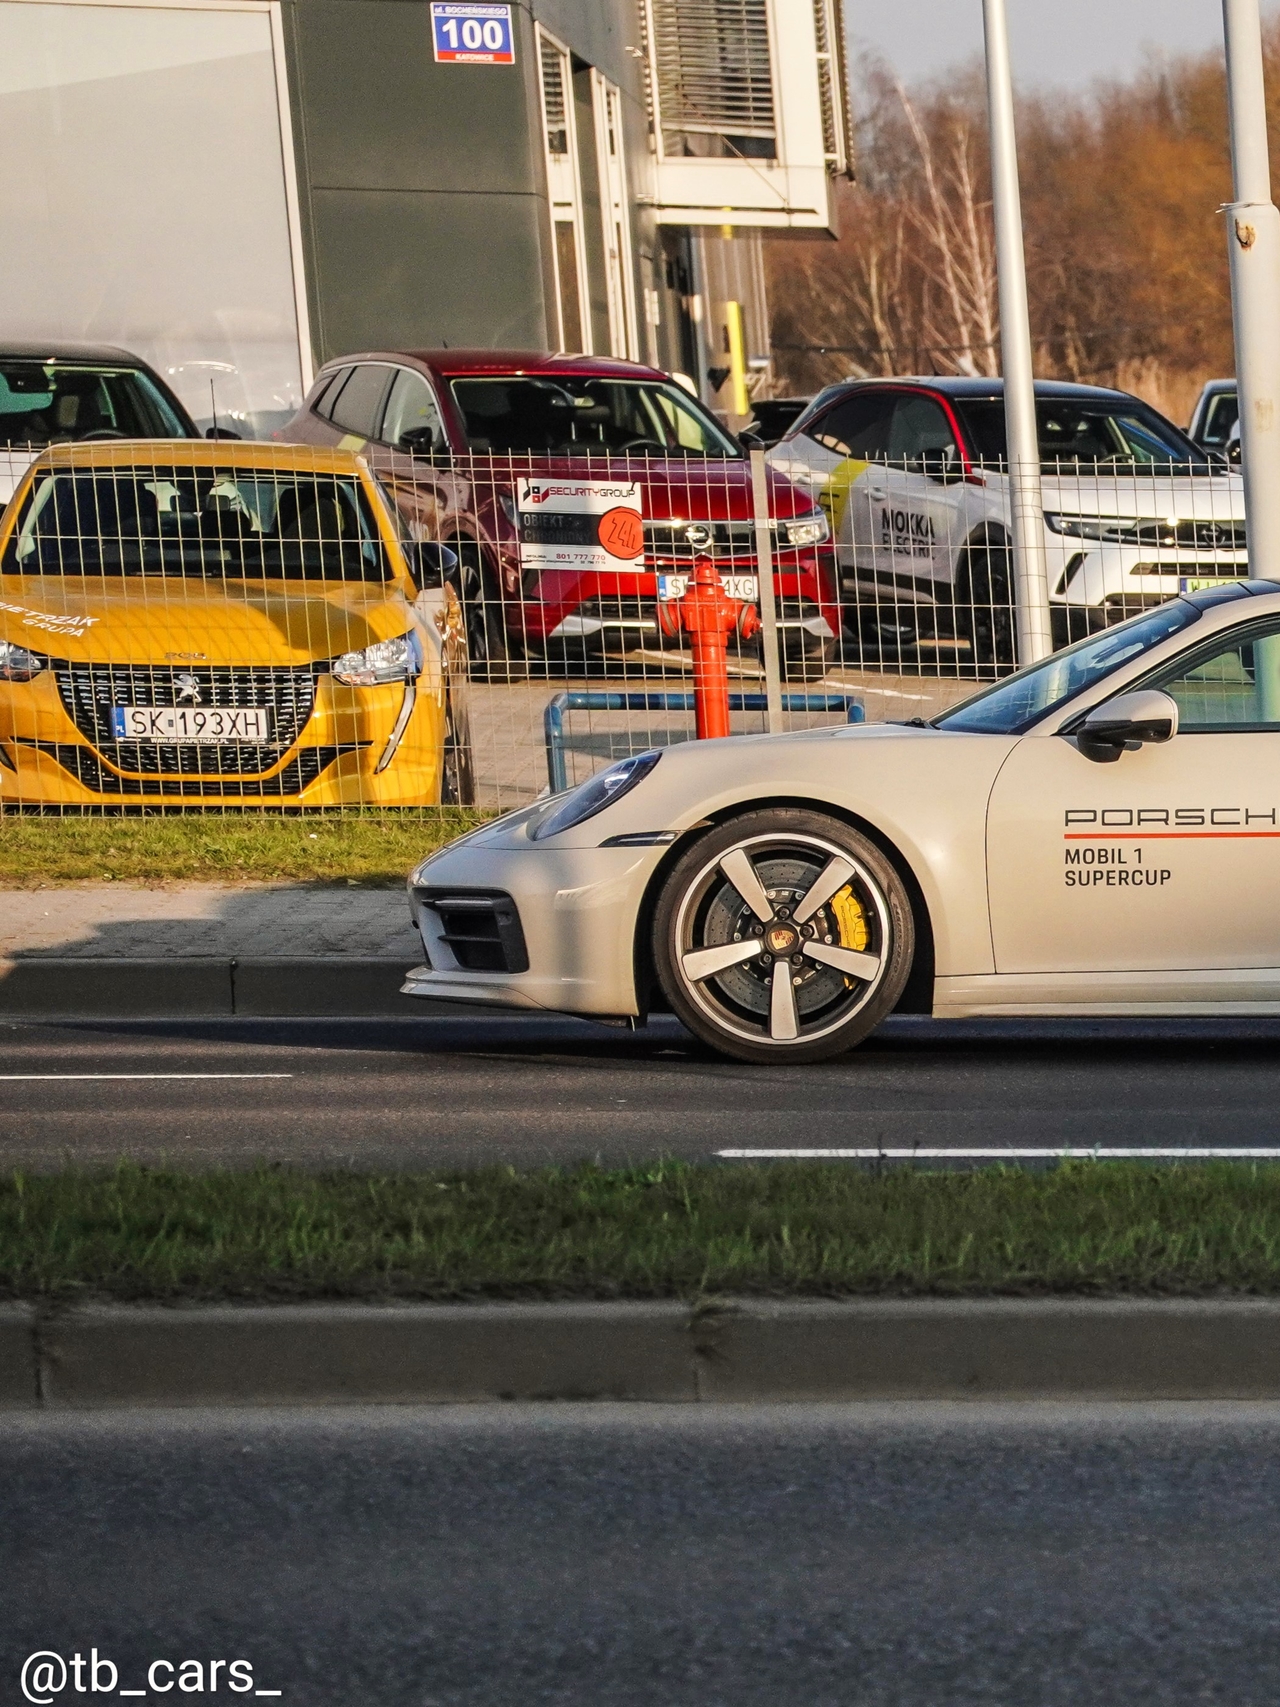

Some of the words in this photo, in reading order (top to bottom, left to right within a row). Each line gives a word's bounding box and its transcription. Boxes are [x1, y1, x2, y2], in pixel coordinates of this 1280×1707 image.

[442, 18, 503, 50] 100
[881, 508, 935, 539] MOKKA
[22, 619, 84, 637] GRUPA
[131, 710, 165, 736] SK
[178, 711, 261, 736] 193XH
[1064, 848, 1127, 864] MOBIL
[1134, 848, 1143, 864] 1
[1064, 869, 1172, 886] SUPERCUP
